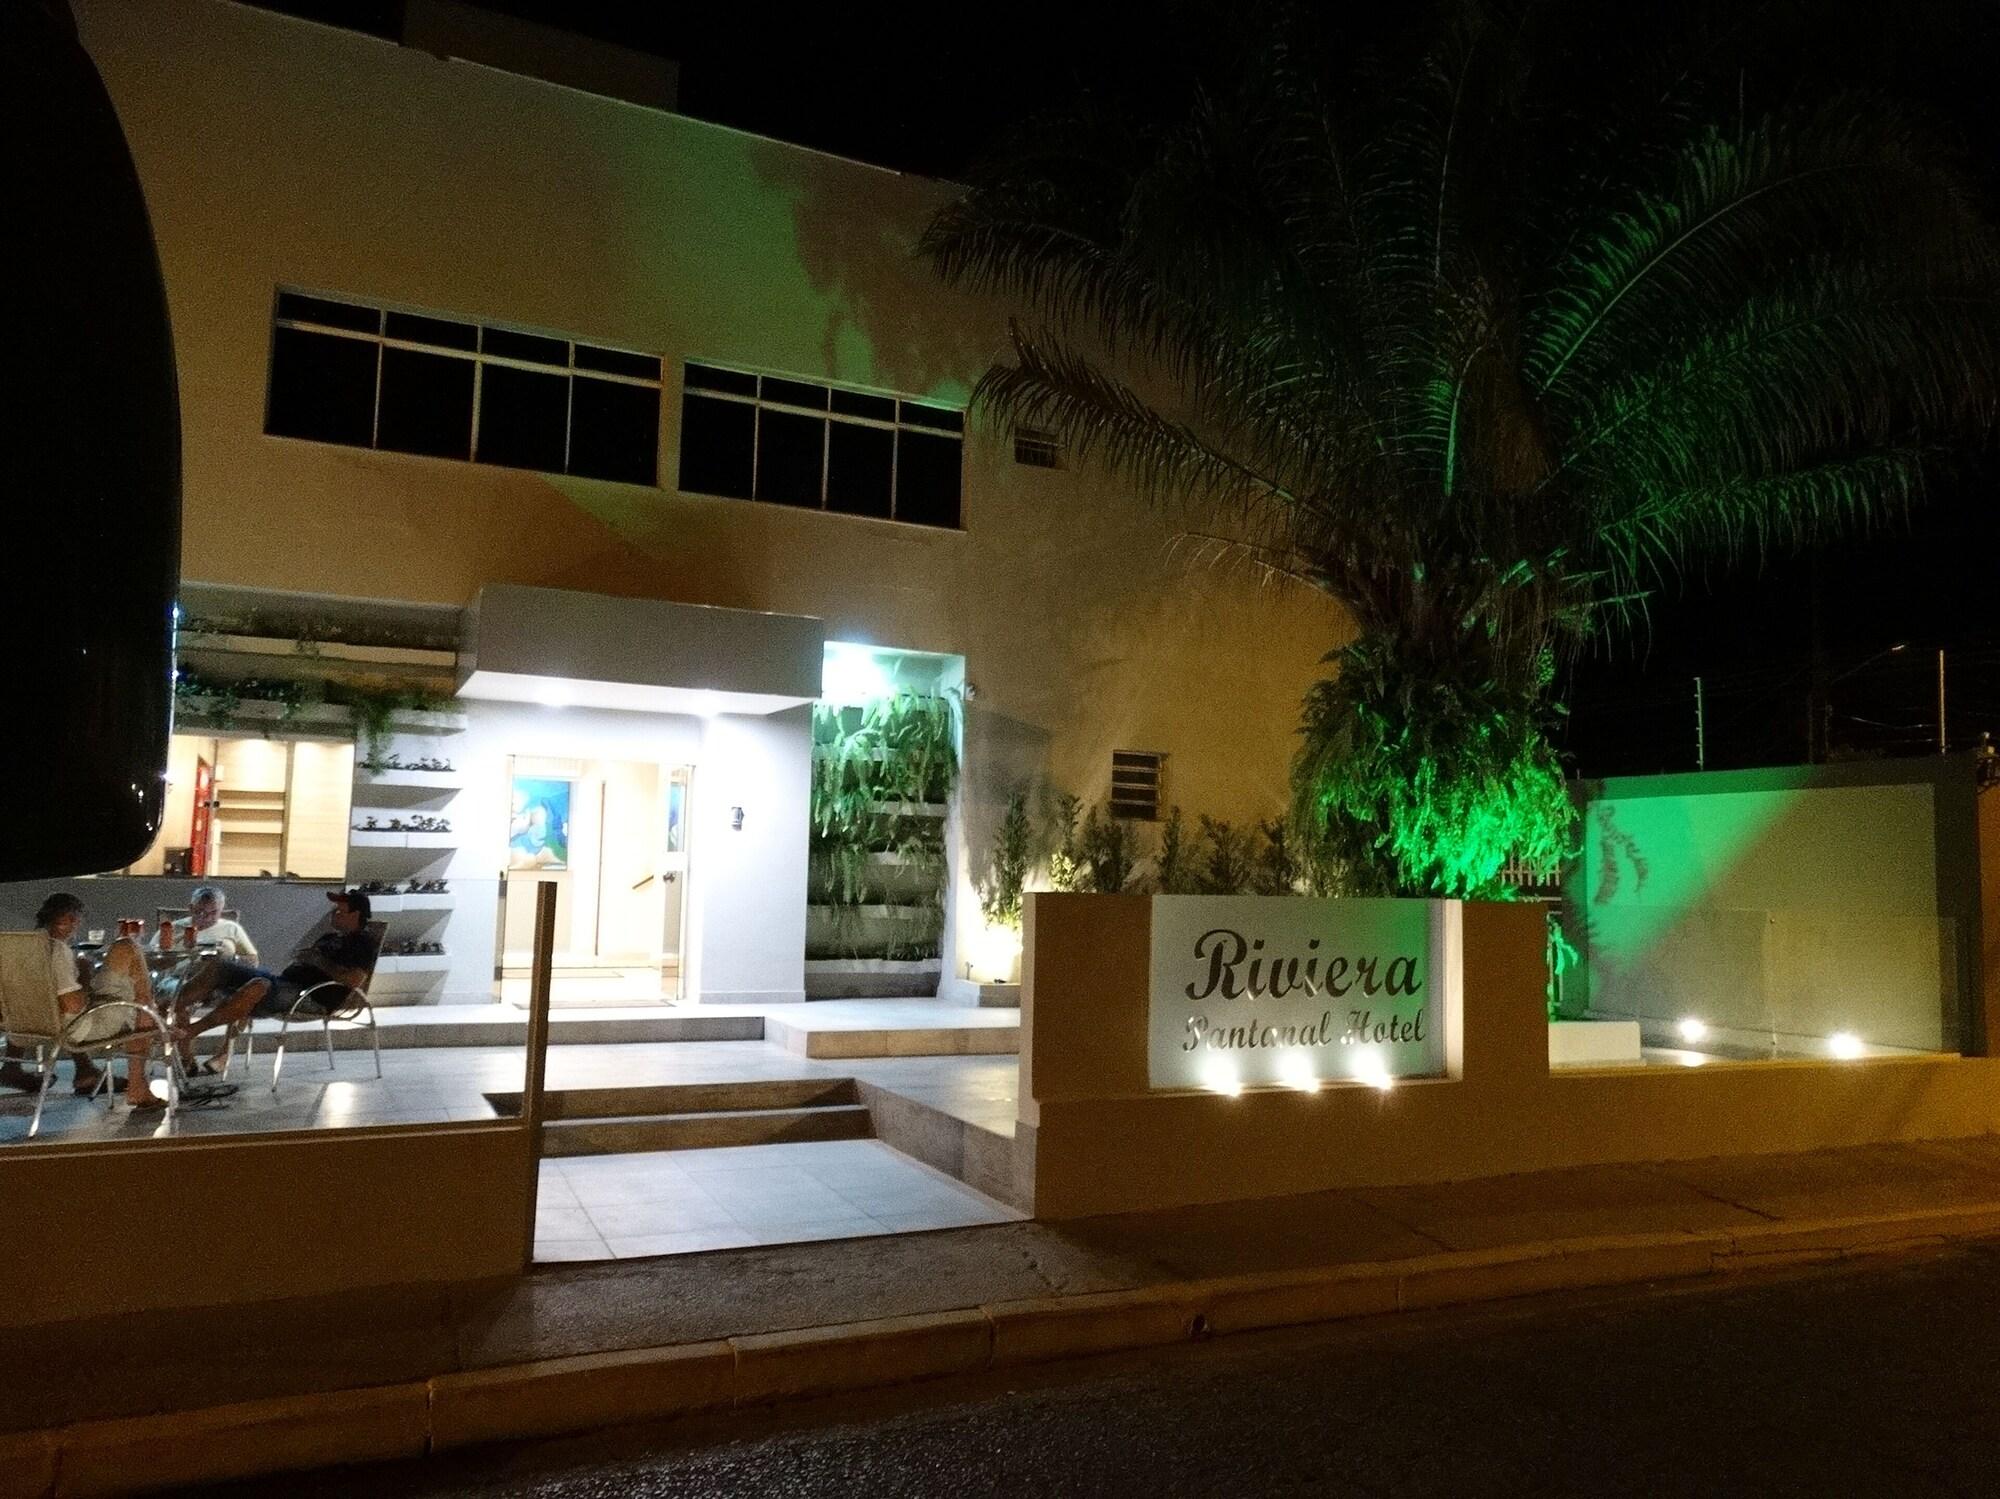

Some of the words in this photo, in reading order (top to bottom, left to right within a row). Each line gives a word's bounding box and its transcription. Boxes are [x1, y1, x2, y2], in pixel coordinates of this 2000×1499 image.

[1185, 929, 1422, 1000] Riviera
[1183, 1011, 1331, 1052] Pantanal
[1341, 1008, 1425, 1045] Hotel
